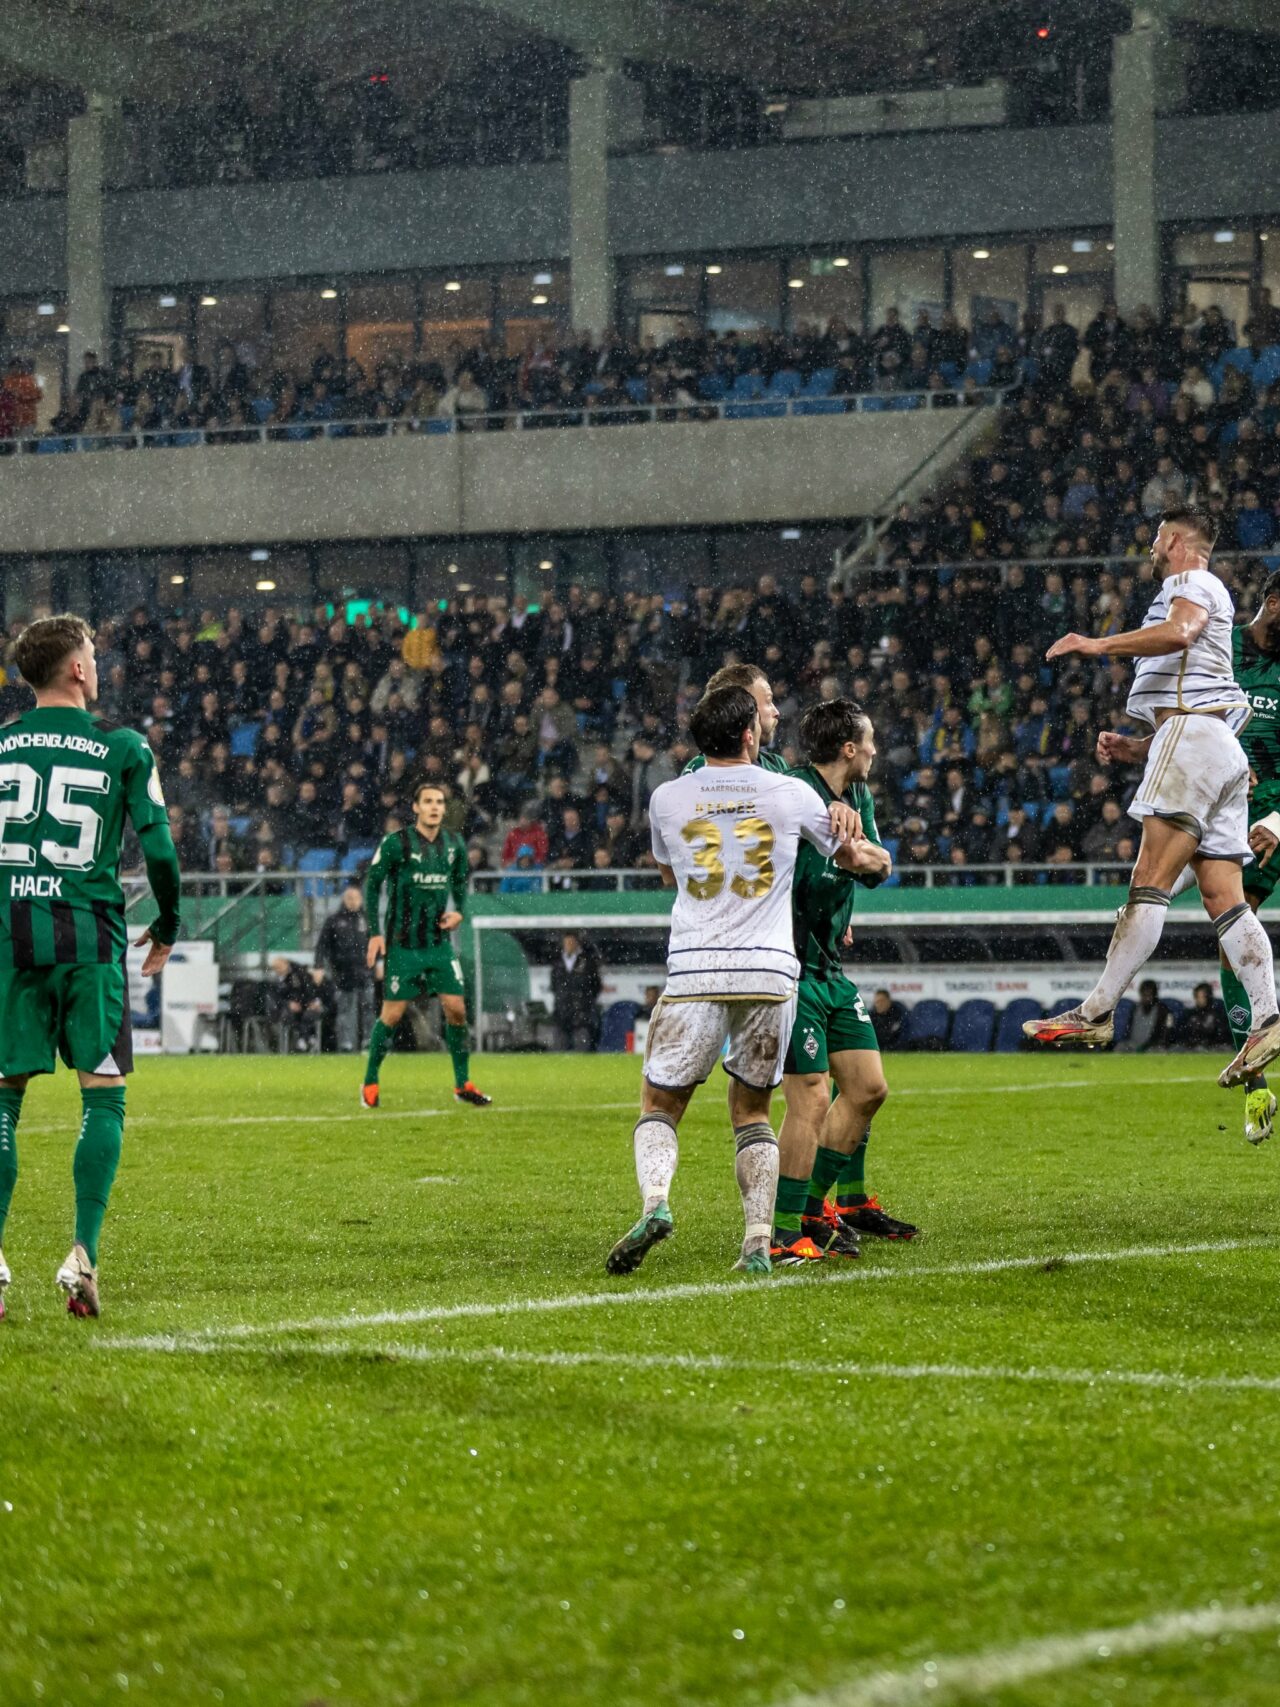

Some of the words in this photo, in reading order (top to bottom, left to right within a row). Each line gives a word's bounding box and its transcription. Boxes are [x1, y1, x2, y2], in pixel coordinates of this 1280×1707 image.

[0, 763, 111, 872] 25
[680, 817, 776, 901] 33
[10, 874, 63, 898] HACK
